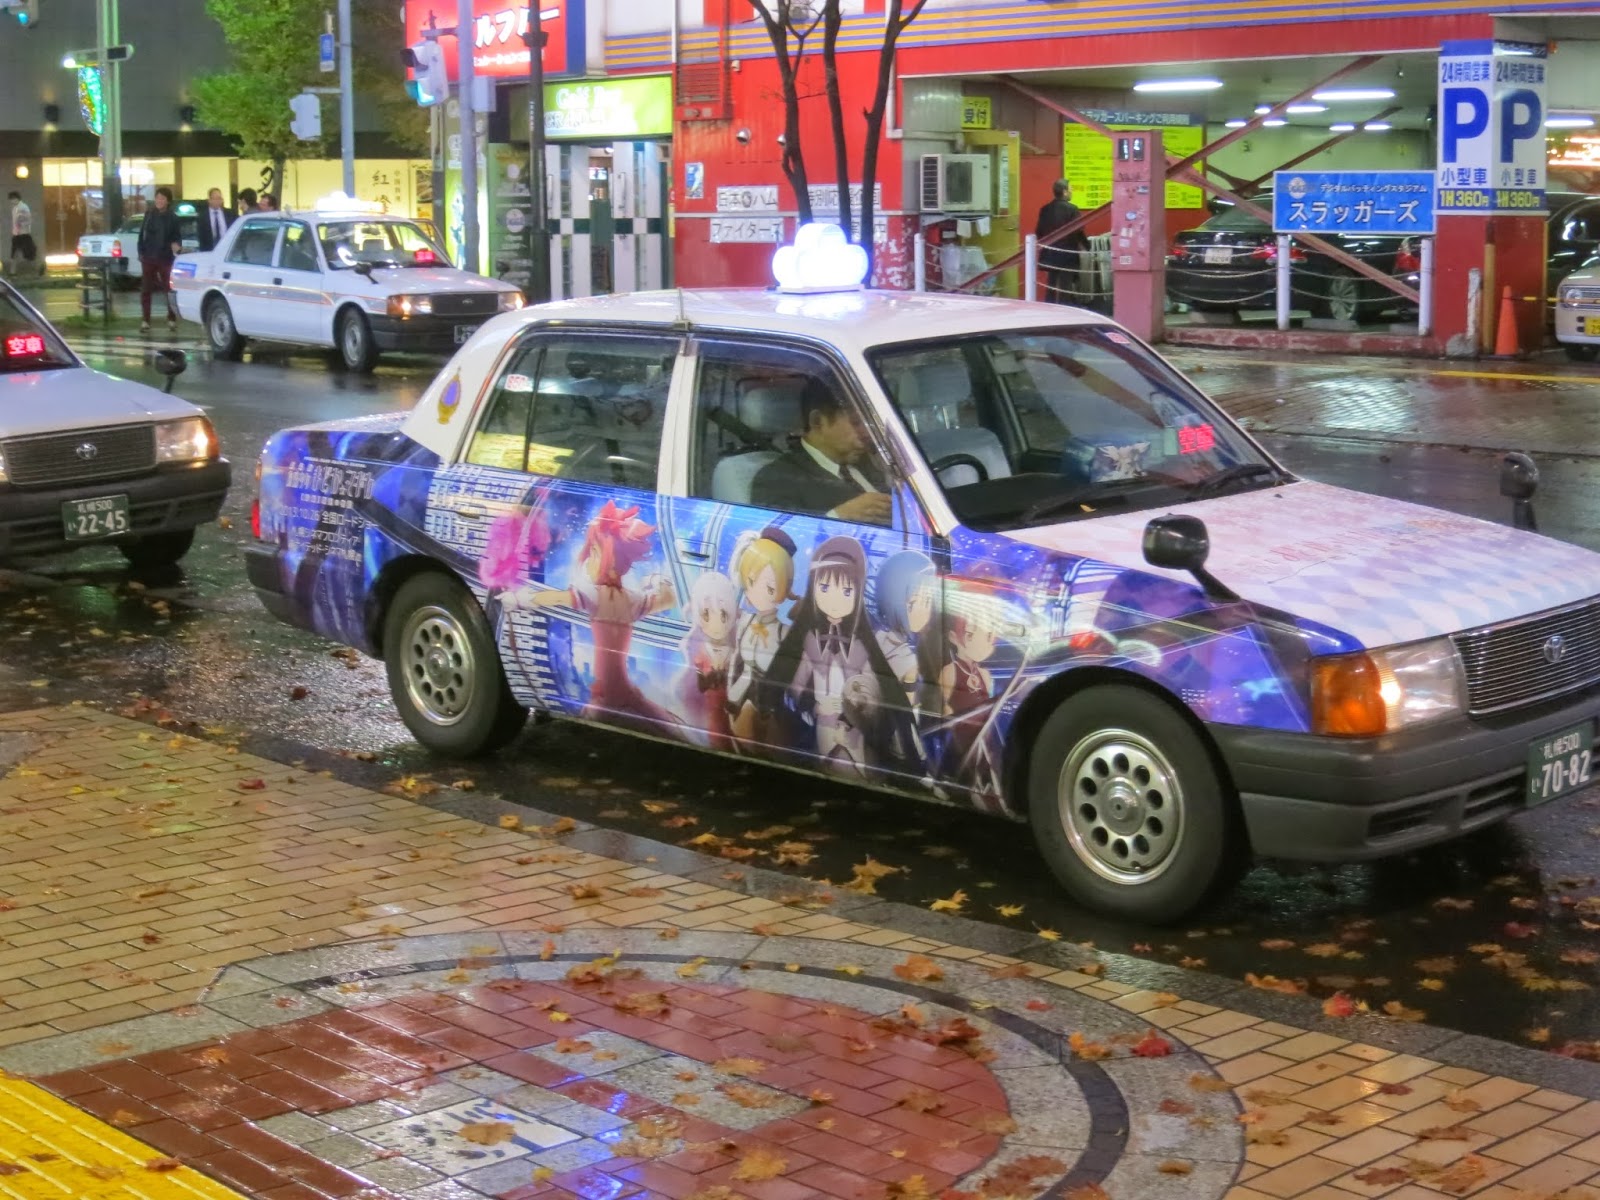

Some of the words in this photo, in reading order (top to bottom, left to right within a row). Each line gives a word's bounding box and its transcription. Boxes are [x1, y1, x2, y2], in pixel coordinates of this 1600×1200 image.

[472, 7, 560, 48] ルフー
[1442, 61, 1490, 83] 24時間営業
[1497, 61, 1544, 83] 24時間営業
[964, 108, 987, 125] 受付
[1443, 87, 1489, 163] P
[1500, 88, 1541, 163] P
[1441, 167, 1487, 186] 小型車
[1501, 168, 1537, 186] 小型車
[1288, 199, 1420, 223] スラッガーズ
[7, 336, 44, 355] 空車
[78, 509, 126, 534] 22-45
[1542, 749, 1590, 797] 70-82
